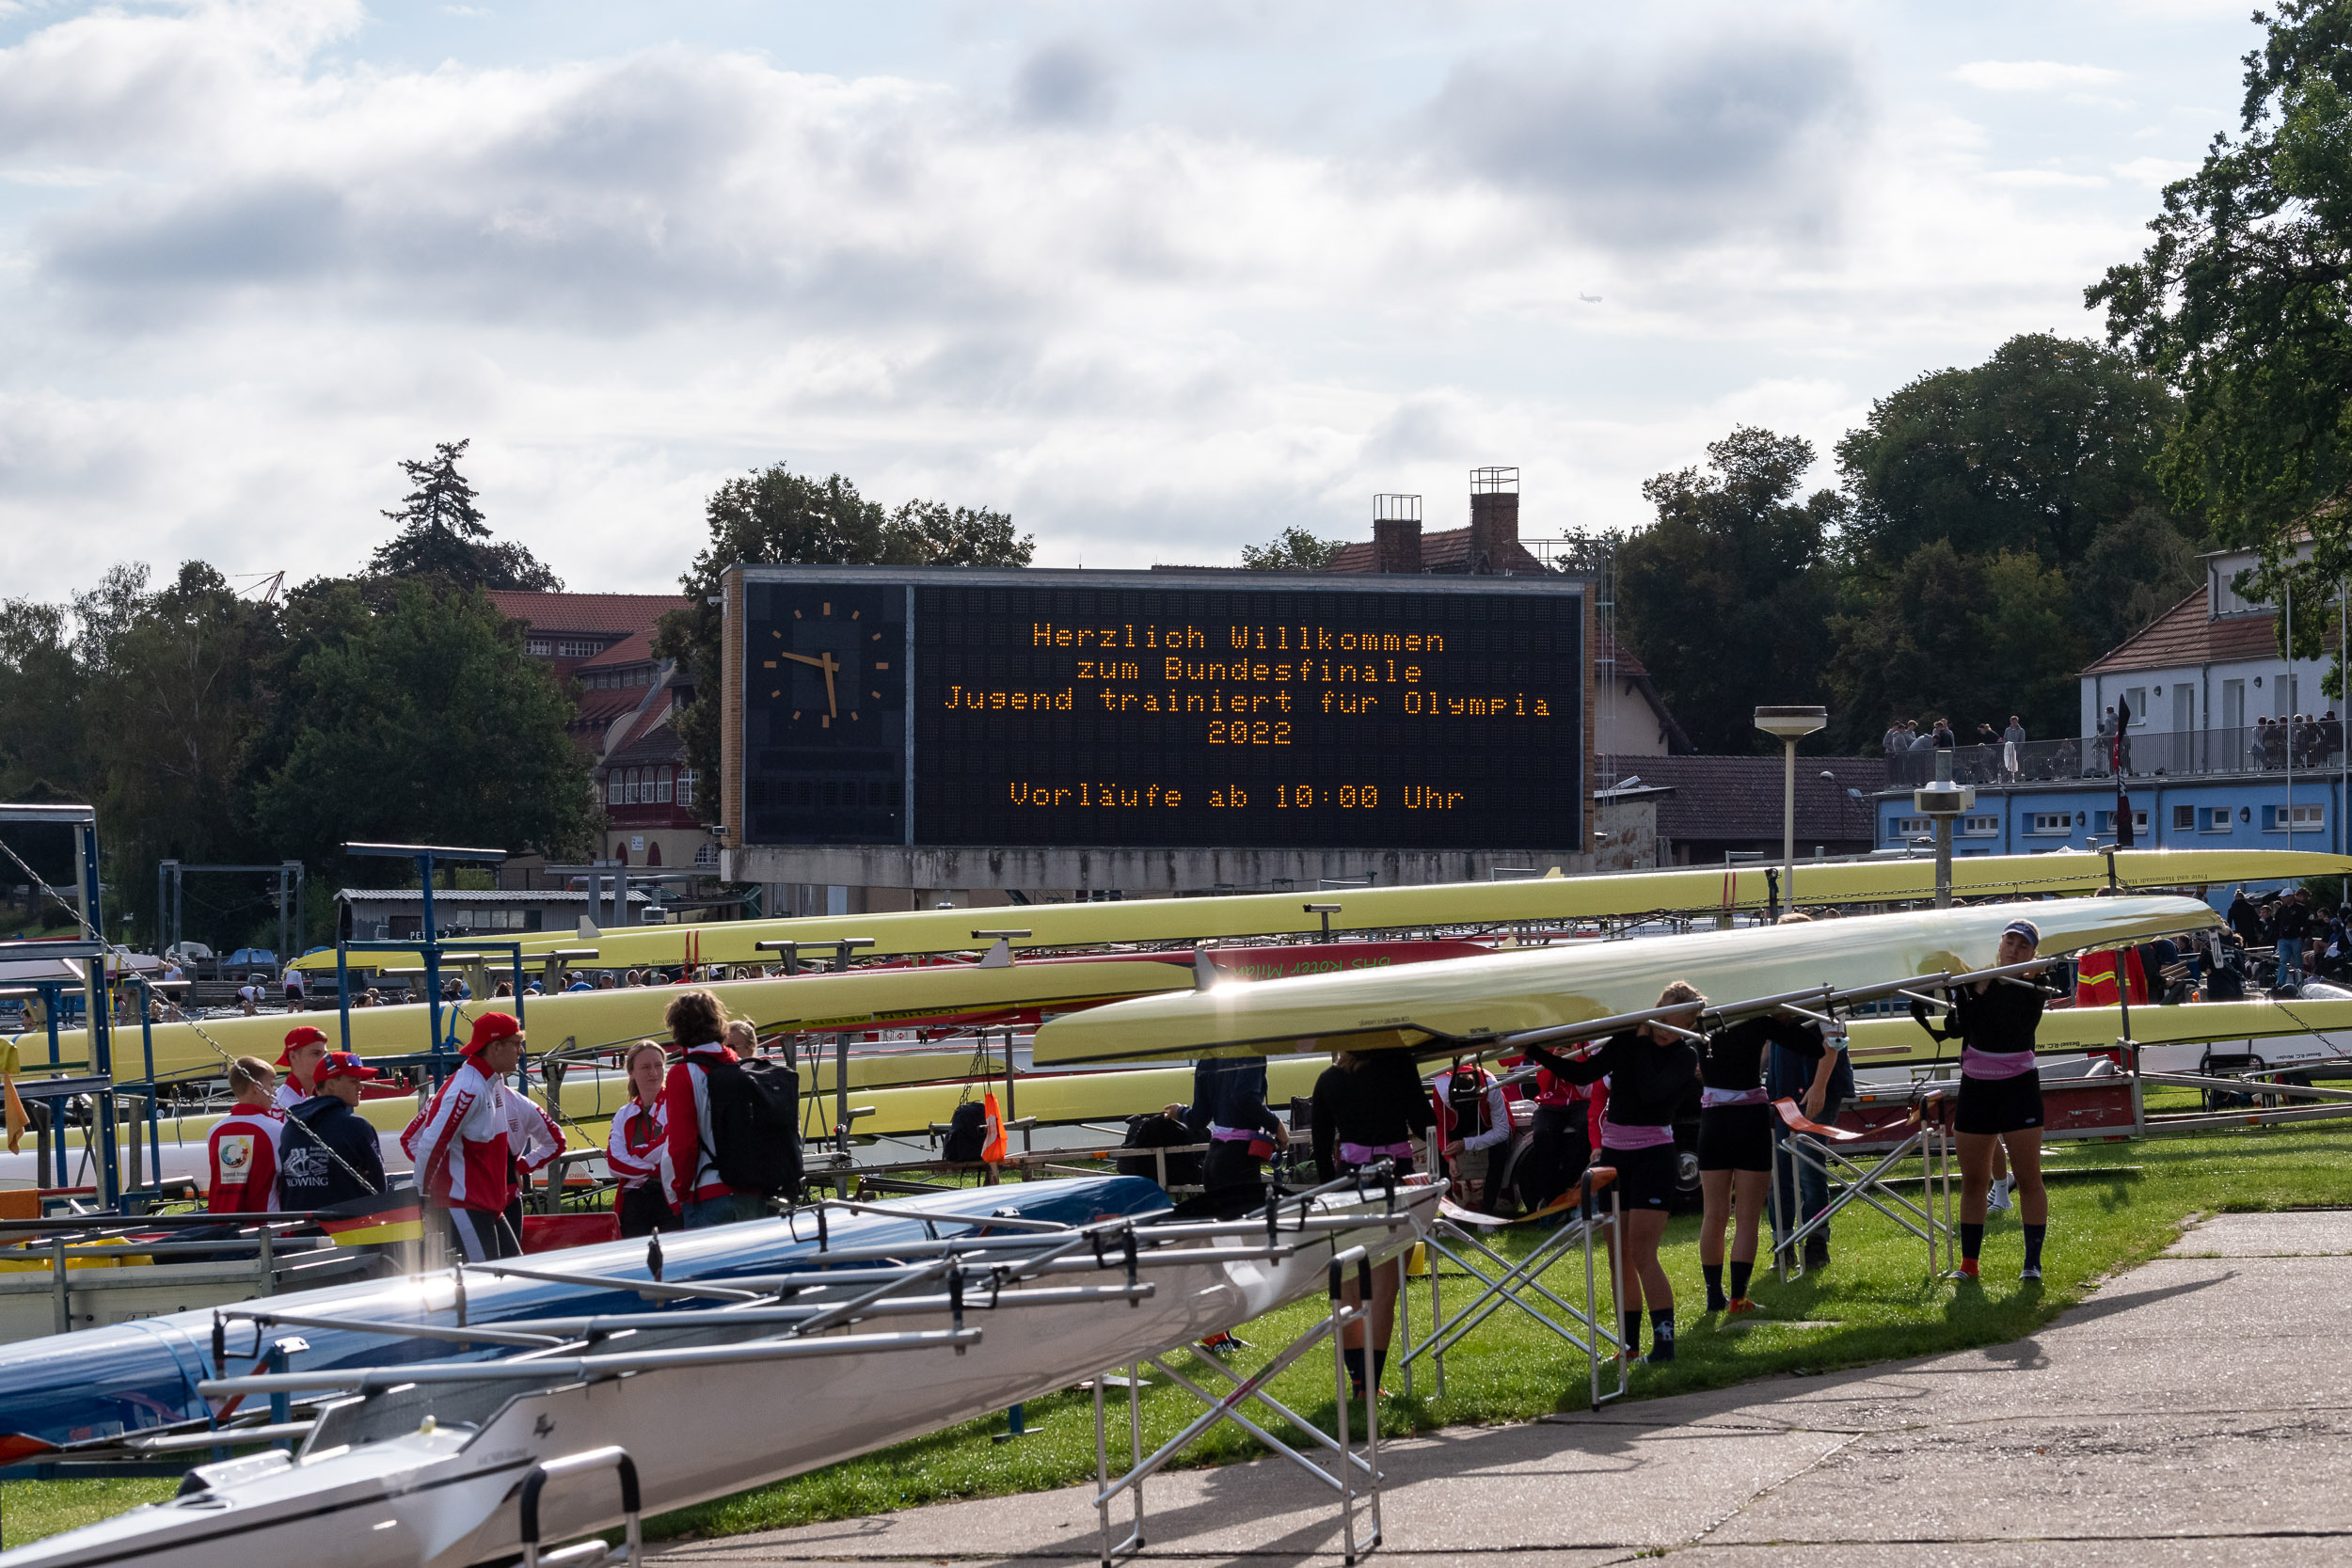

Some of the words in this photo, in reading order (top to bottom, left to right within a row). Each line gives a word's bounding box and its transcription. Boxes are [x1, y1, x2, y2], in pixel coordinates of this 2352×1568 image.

[1033, 623, 1204, 648] Herzlich
[1231, 626, 1444, 651] Willkommen
[1077, 661, 1139, 679] zum
[1165, 657, 1422, 682] Bundesfinale
[945, 686, 1073, 709] Jugend
[1099, 688, 1292, 712] trainiert
[1321, 690, 1379, 713] für
[1405, 691, 1550, 716] Olympia
[1209, 721, 1292, 744] 2022
[1010, 783, 1183, 806] Vorläufe
[1209, 784, 1248, 807] ab
[1277, 784, 1378, 808] 10:00
[1405, 785, 1465, 809] Uhr
[1232, 962, 1283, 981] Milan
[811, 1016, 871, 1025] MEIER
[881, 1008, 962, 1021] JOCHEN
[286, 1177, 328, 1187] ROWING
